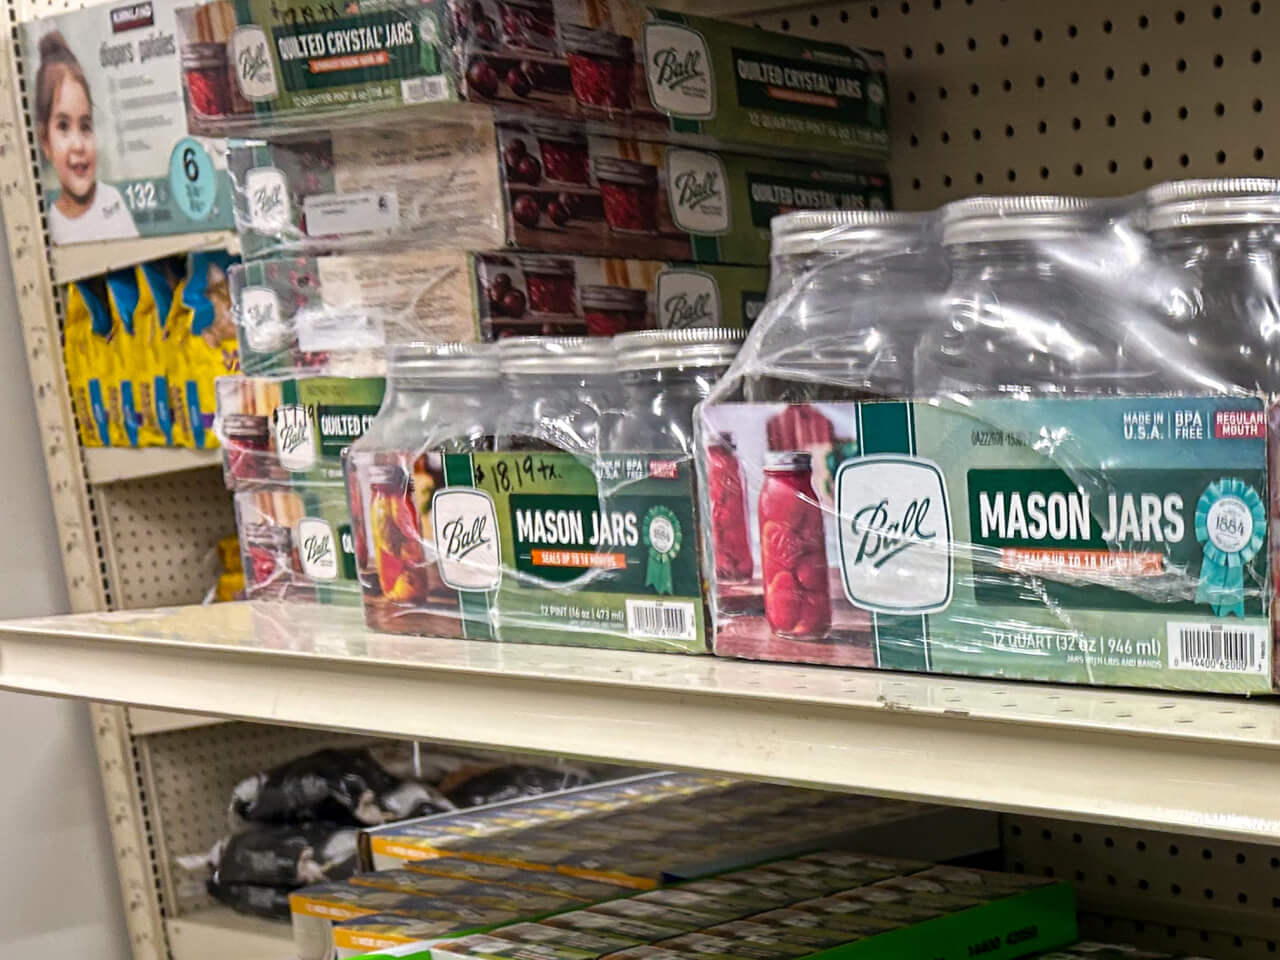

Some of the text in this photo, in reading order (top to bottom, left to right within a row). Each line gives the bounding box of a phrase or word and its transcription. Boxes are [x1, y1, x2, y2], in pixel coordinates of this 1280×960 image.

[278, 22, 413, 60] QUILTED CRYSTAL JARS
[654, 47, 701, 89] Ball
[183, 148, 199, 181] 6
[125, 183, 157, 209] 132
[675, 170, 719, 208] Ball
[321, 414, 361, 436] QUILTED
[1123, 412, 1164, 425] MADE IN
[1175, 410, 1202, 426] BPA
[1216, 411, 1267, 425] REGULAR
[1222, 424, 1258, 436] MOUTH
[1123, 425, 1164, 440] U.S.A.
[1175, 426, 1203, 439] FREE
[515, 508, 639, 547] MASON JARS
[979, 491, 1185, 543] MASON JARS
[442, 514, 491, 562] Ball
[852, 498, 936, 568] Ball
[304, 535, 331, 564] Ball
[1069, 554, 1082, 569] TO
[1006, 634, 1052, 651] QUART
[1056, 634, 1075, 651] (32
[1079, 640, 1097, 652] oz
[1108, 640, 1133, 655] 946
[1136, 639, 1161, 656] ml)
